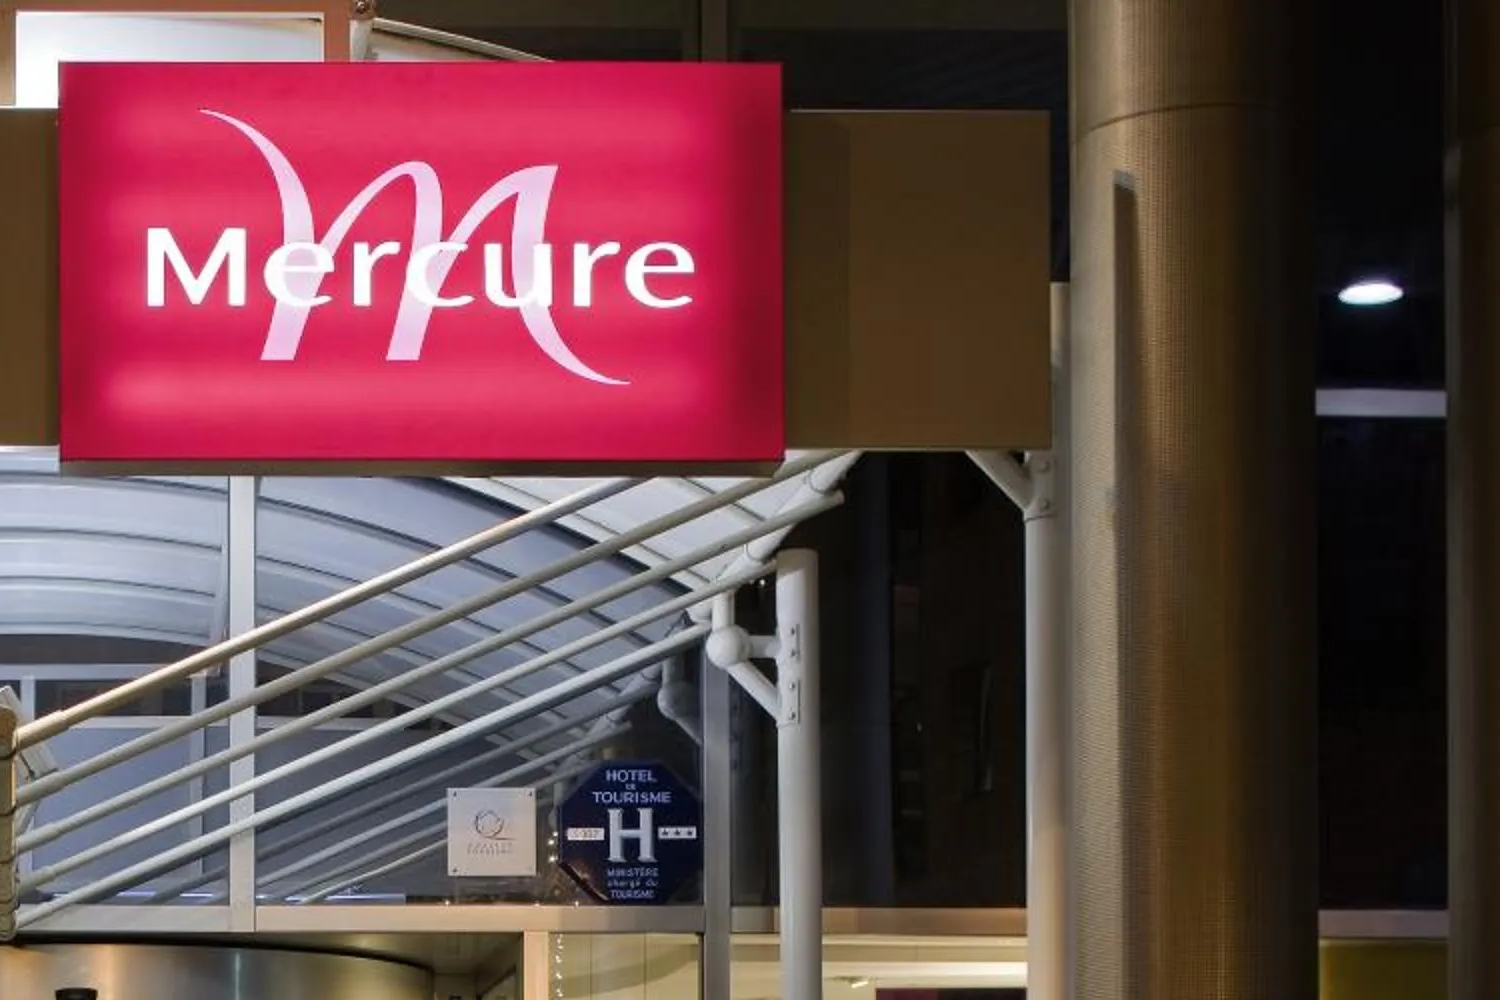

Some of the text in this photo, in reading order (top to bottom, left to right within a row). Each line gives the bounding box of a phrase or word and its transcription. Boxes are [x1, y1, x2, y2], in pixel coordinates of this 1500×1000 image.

[145, 226, 696, 309] Mercure
[605, 769, 657, 783] HOTEL
[591, 791, 672, 804] TOURISME
[607, 807, 658, 863] H
